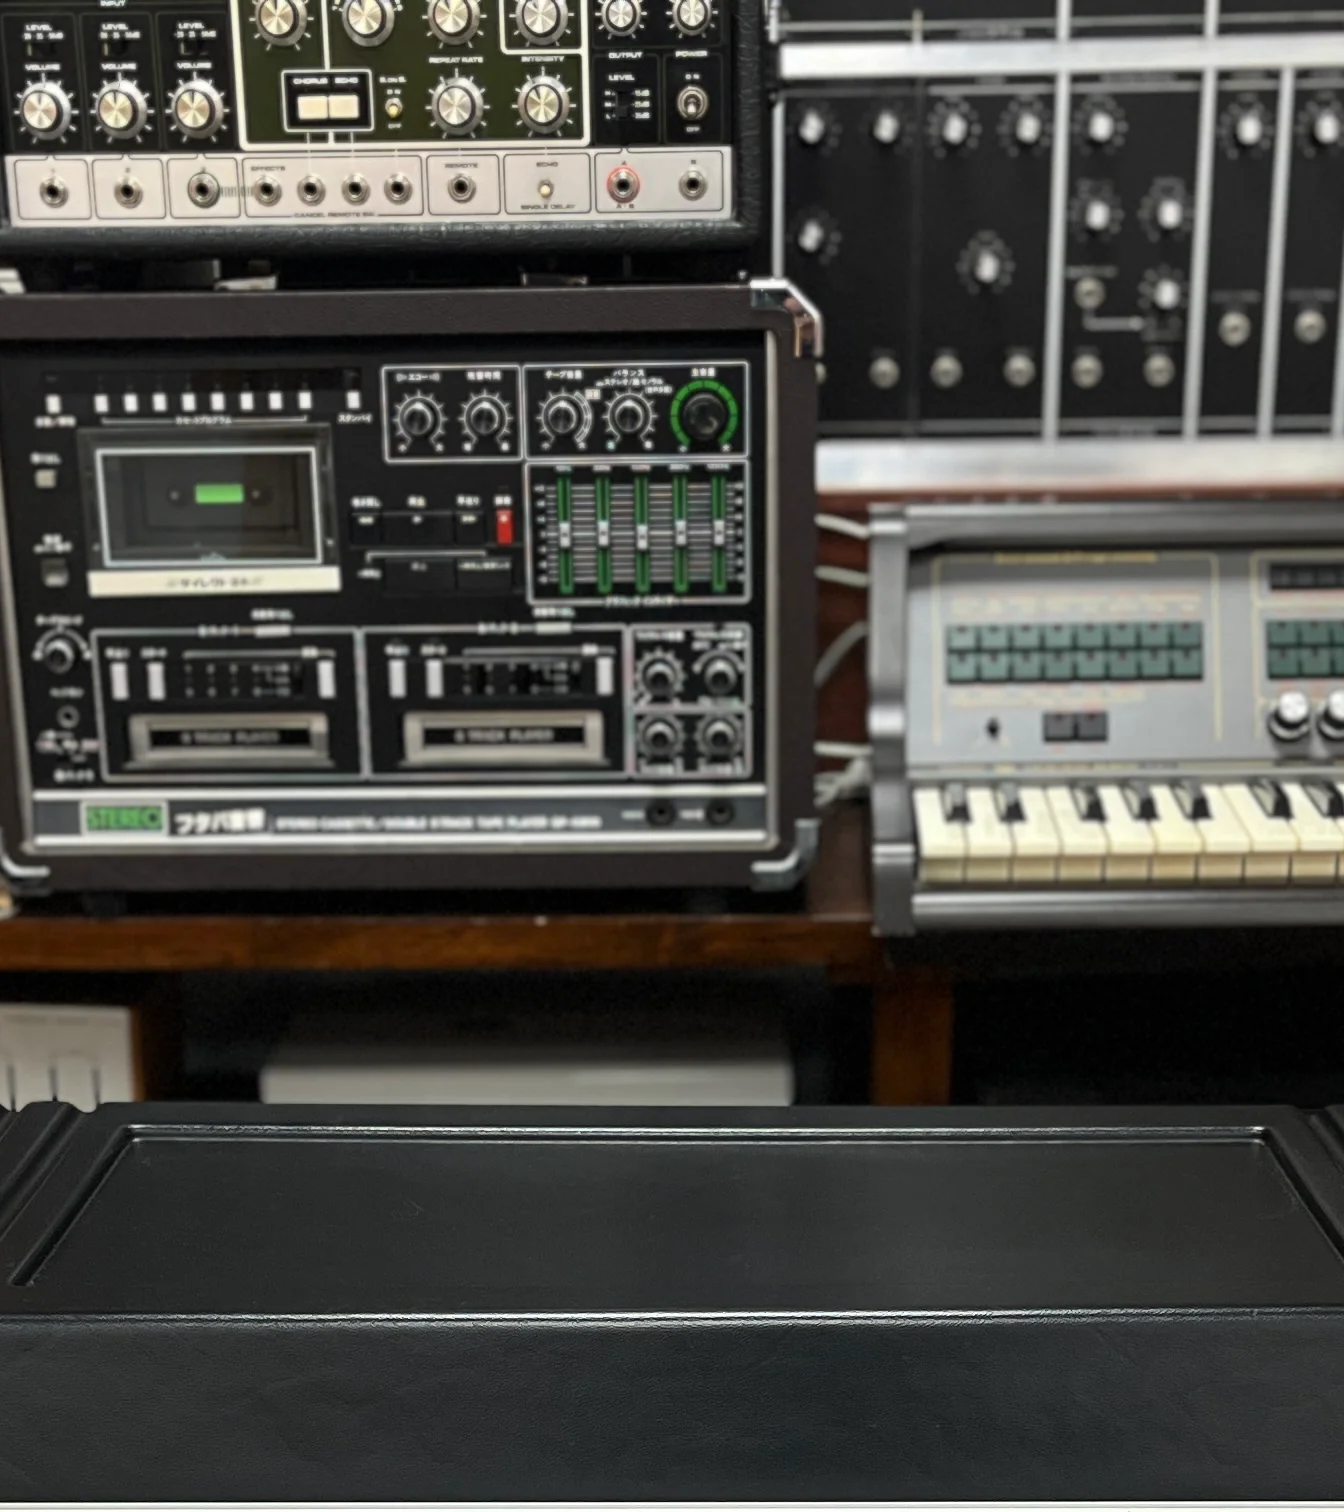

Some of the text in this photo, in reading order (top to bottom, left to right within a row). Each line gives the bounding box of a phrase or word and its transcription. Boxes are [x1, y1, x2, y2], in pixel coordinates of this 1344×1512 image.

[675, 50, 708, 58] POWER
[429, 56, 460, 64] REPEAT
[177, 62, 212, 70] VOLUME
[293, 77, 328, 85] CHORUS
[88, 807, 162, 831] STEREO
